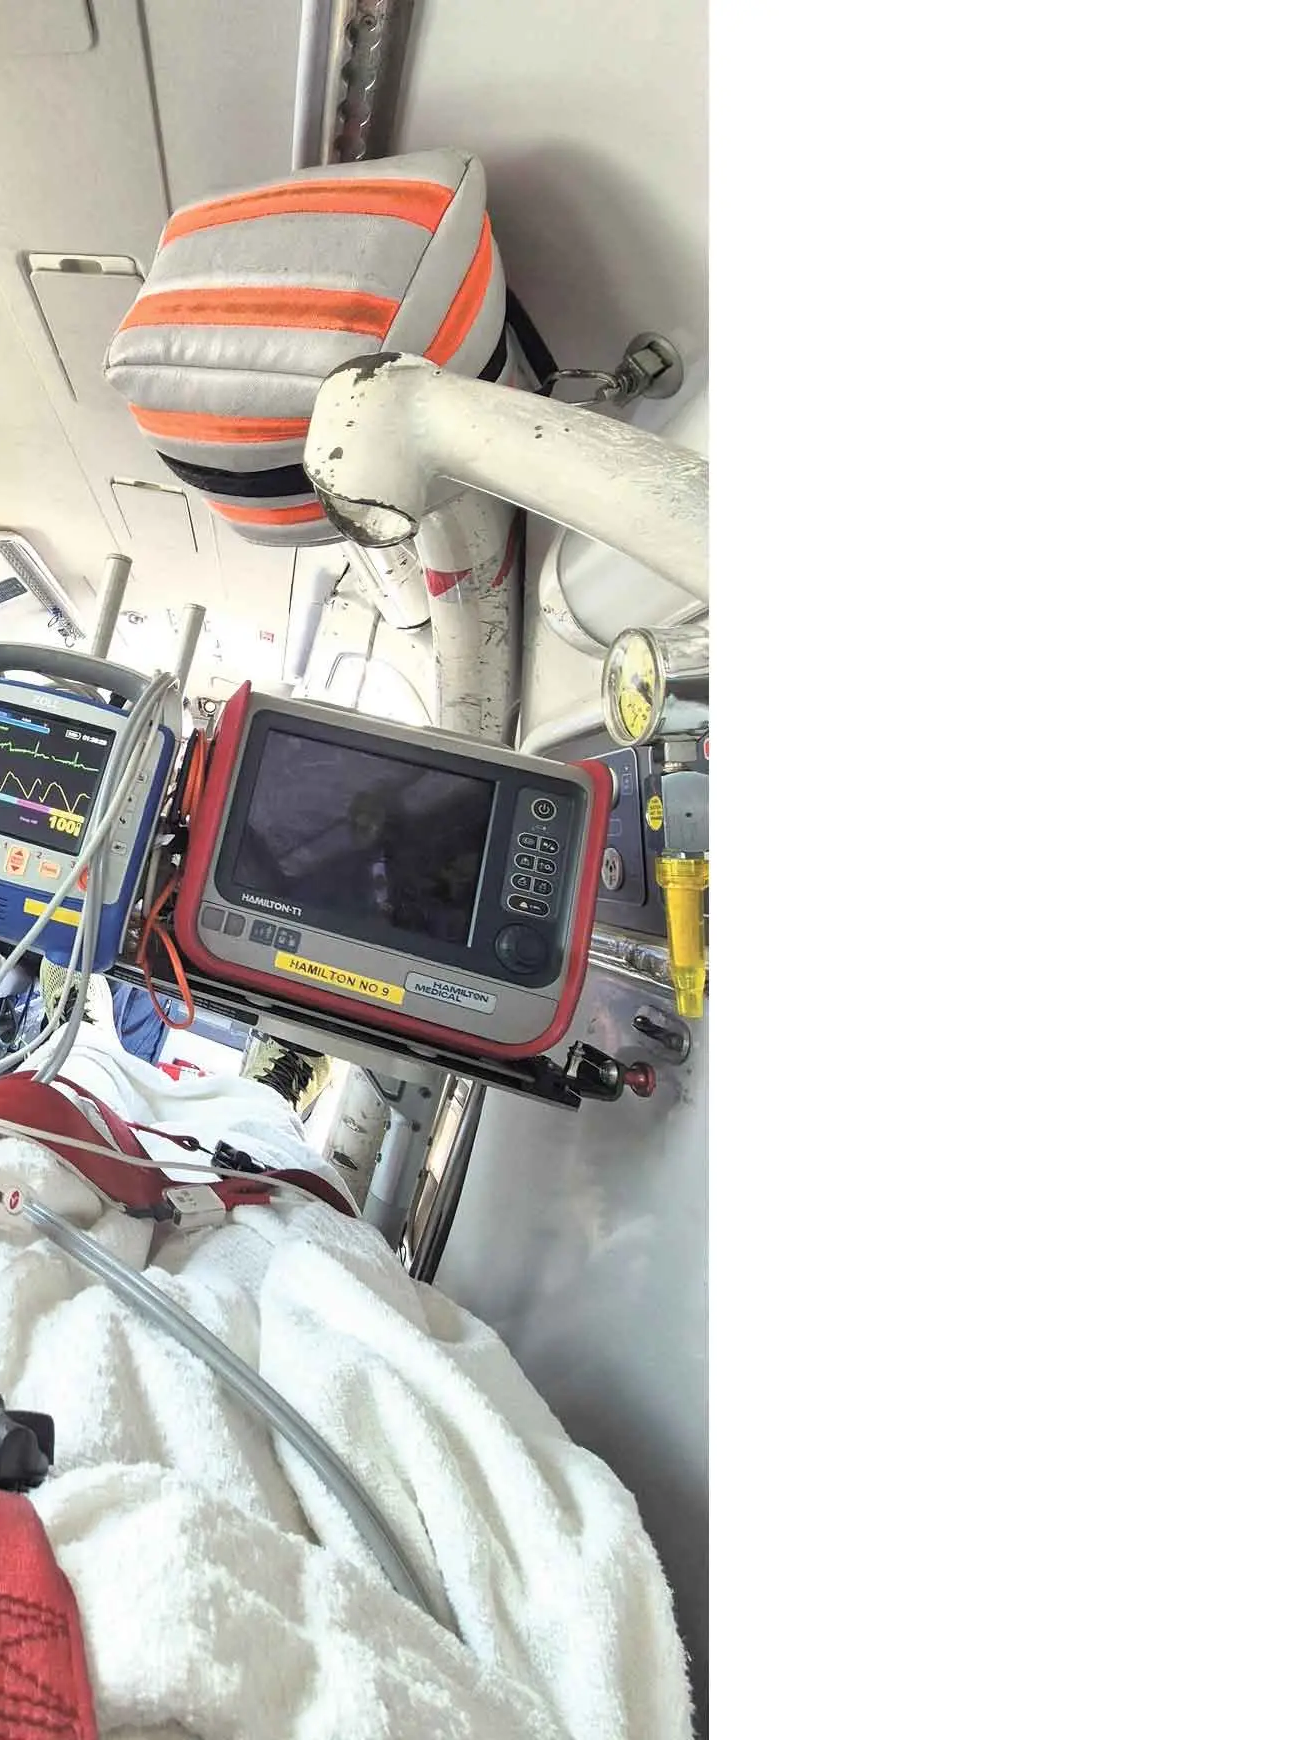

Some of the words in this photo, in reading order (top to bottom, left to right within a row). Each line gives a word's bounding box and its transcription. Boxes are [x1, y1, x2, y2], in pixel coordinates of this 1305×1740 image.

[241, 893, 303, 916] HAMILTON-T1
[289, 958, 356, 986] HAMILTON
[359, 978, 378, 993] NO
[382, 986, 390, 997] 9
[414, 983, 462, 1003] MEDICAL
[432, 981, 489, 1003] HAMILTON
